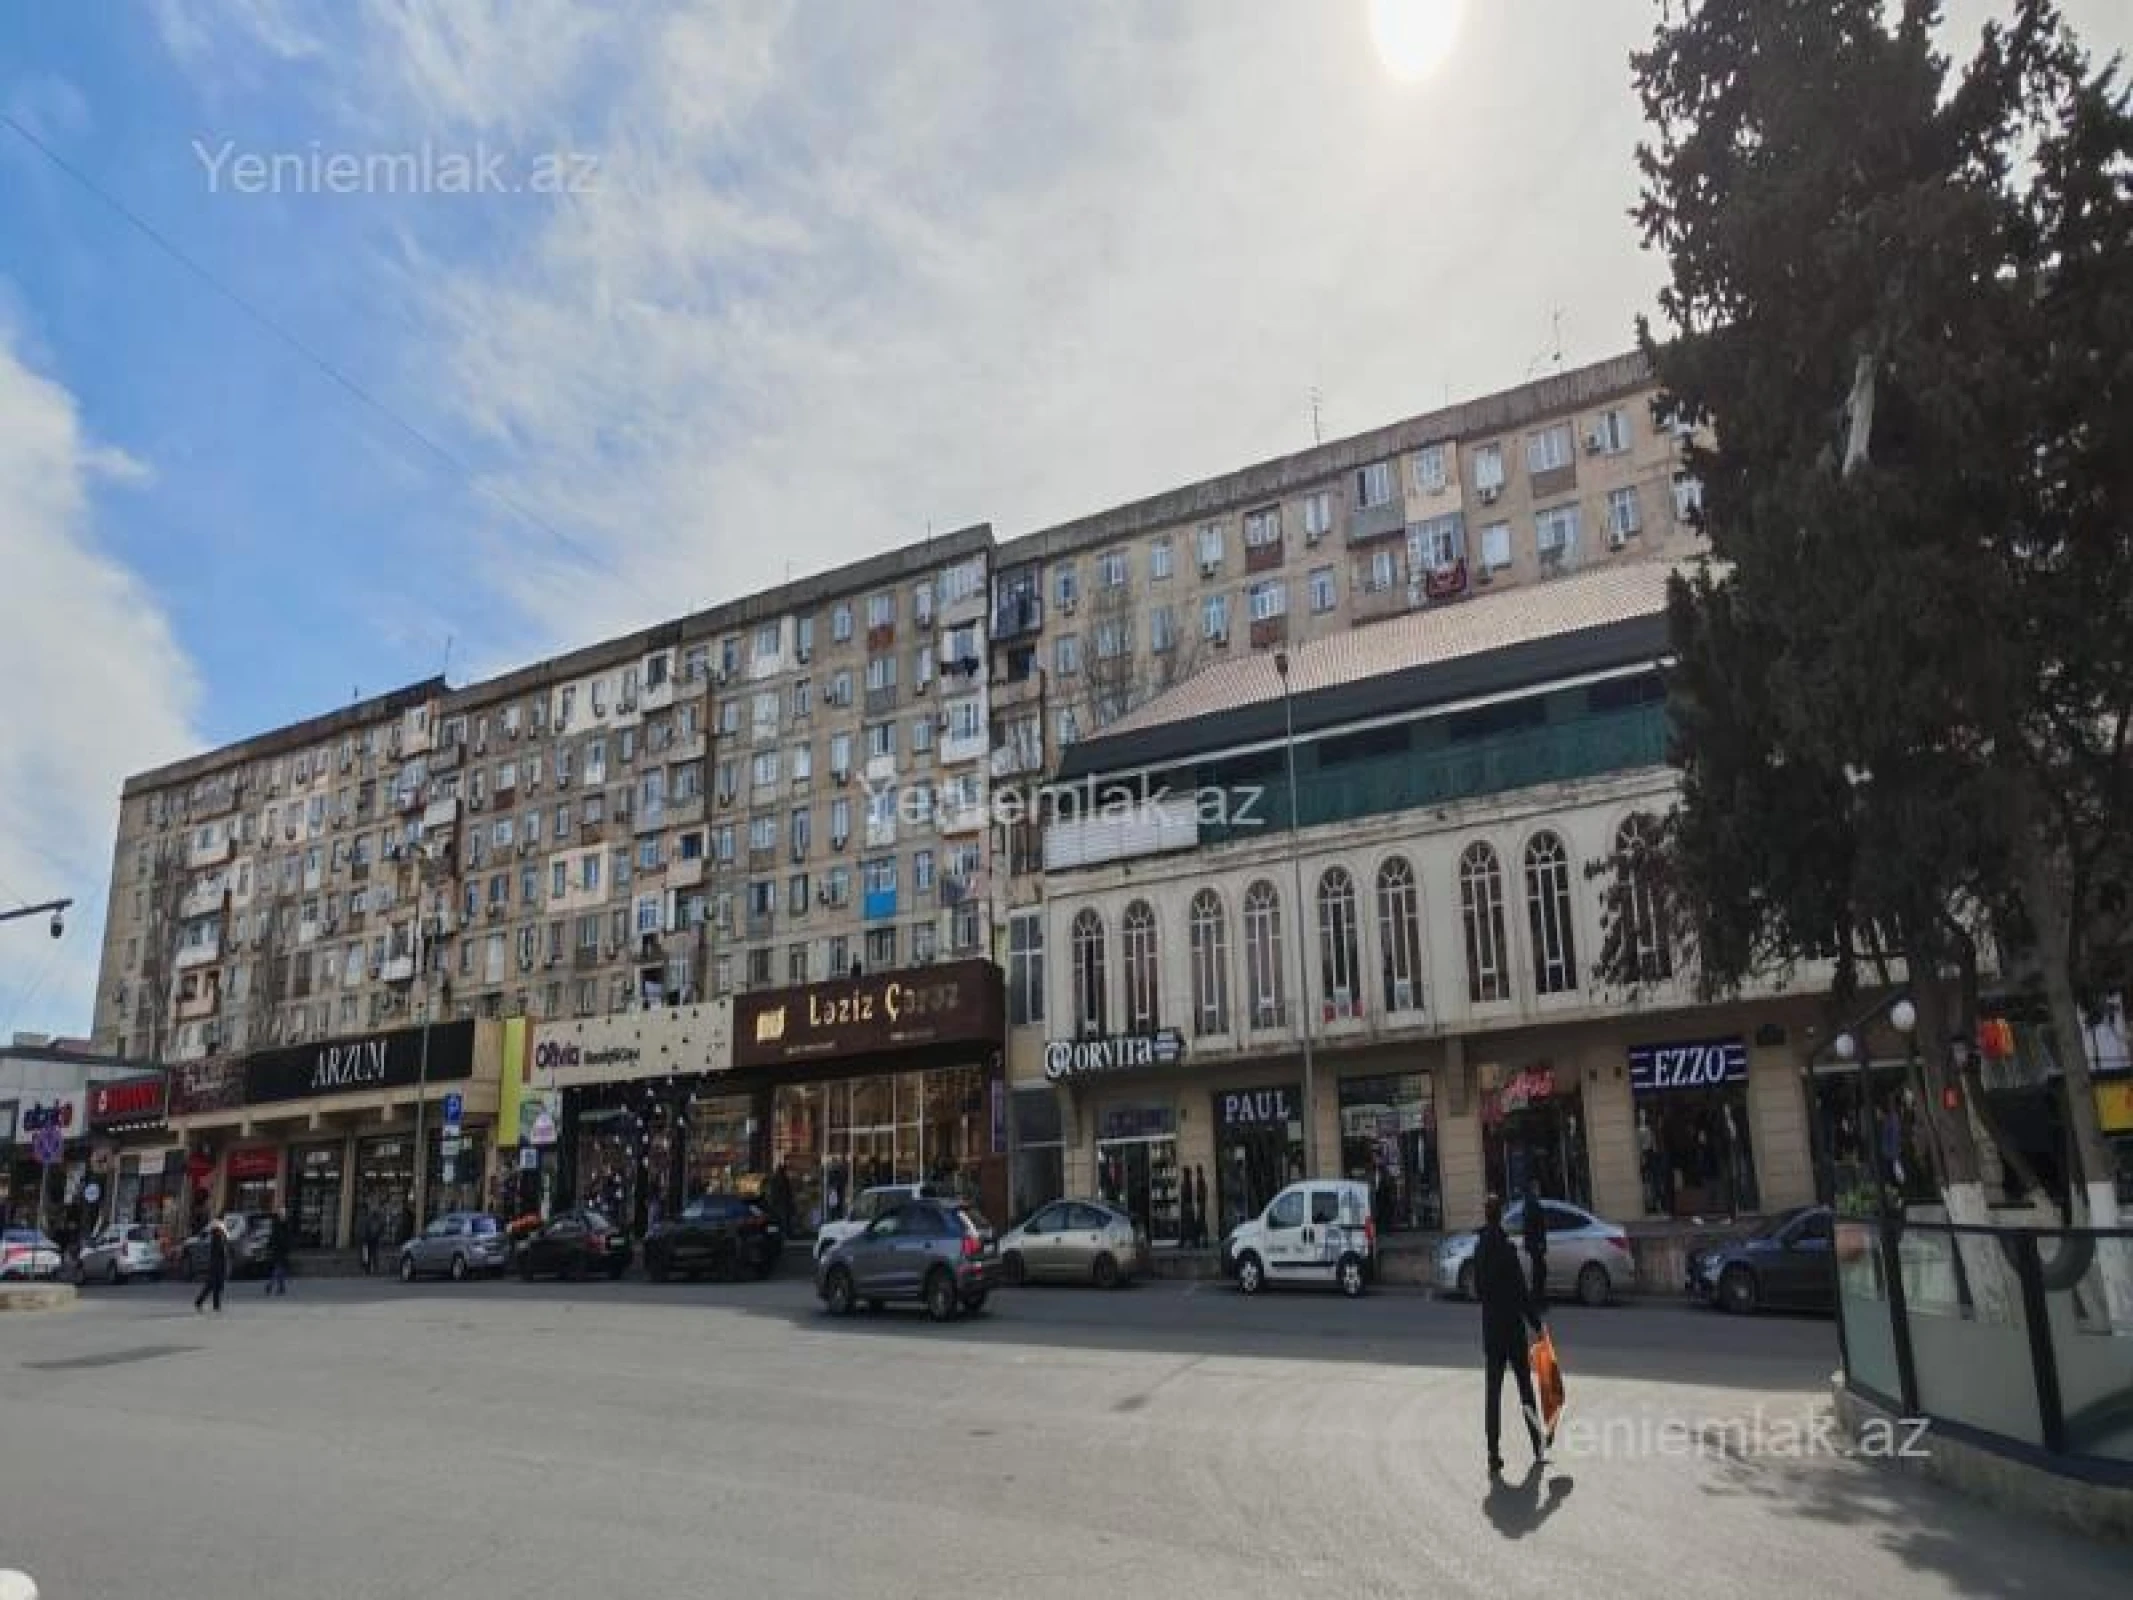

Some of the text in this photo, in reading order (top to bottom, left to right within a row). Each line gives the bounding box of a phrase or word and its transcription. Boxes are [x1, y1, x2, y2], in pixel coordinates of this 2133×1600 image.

[312, 1040, 387, 1088] ARZUM
[1655, 1048, 1725, 1087] EZZO
[1225, 1090, 1289, 1122] PAUL
